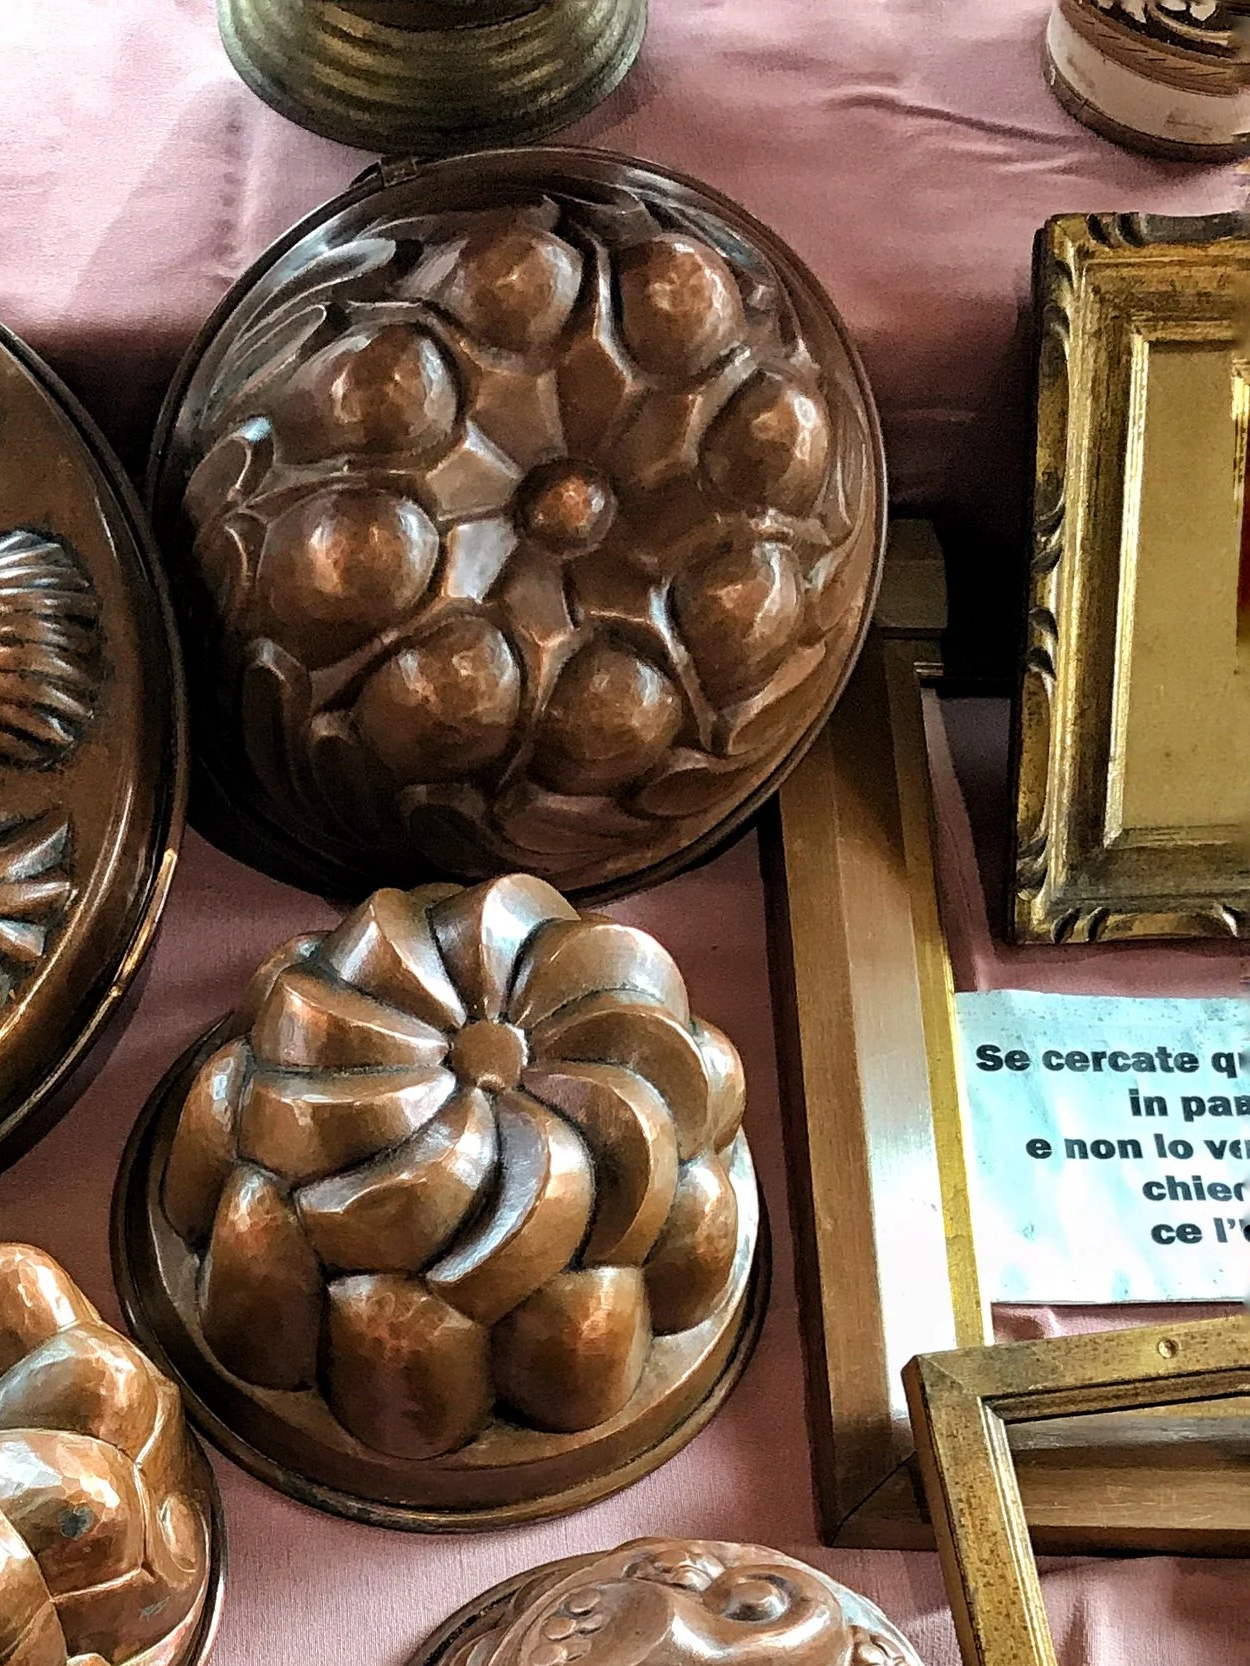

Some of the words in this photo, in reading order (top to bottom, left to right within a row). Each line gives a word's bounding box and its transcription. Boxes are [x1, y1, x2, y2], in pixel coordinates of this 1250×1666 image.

[976, 1044, 1031, 1072] Se
[1042, 1046, 1200, 1073] cercate
[1128, 1088, 1169, 1117] in
[1025, 1138, 1053, 1160] e
[1064, 1138, 1143, 1160] non
[1153, 1133, 1194, 1160] lo
[1151, 1223, 1203, 1245] ce
